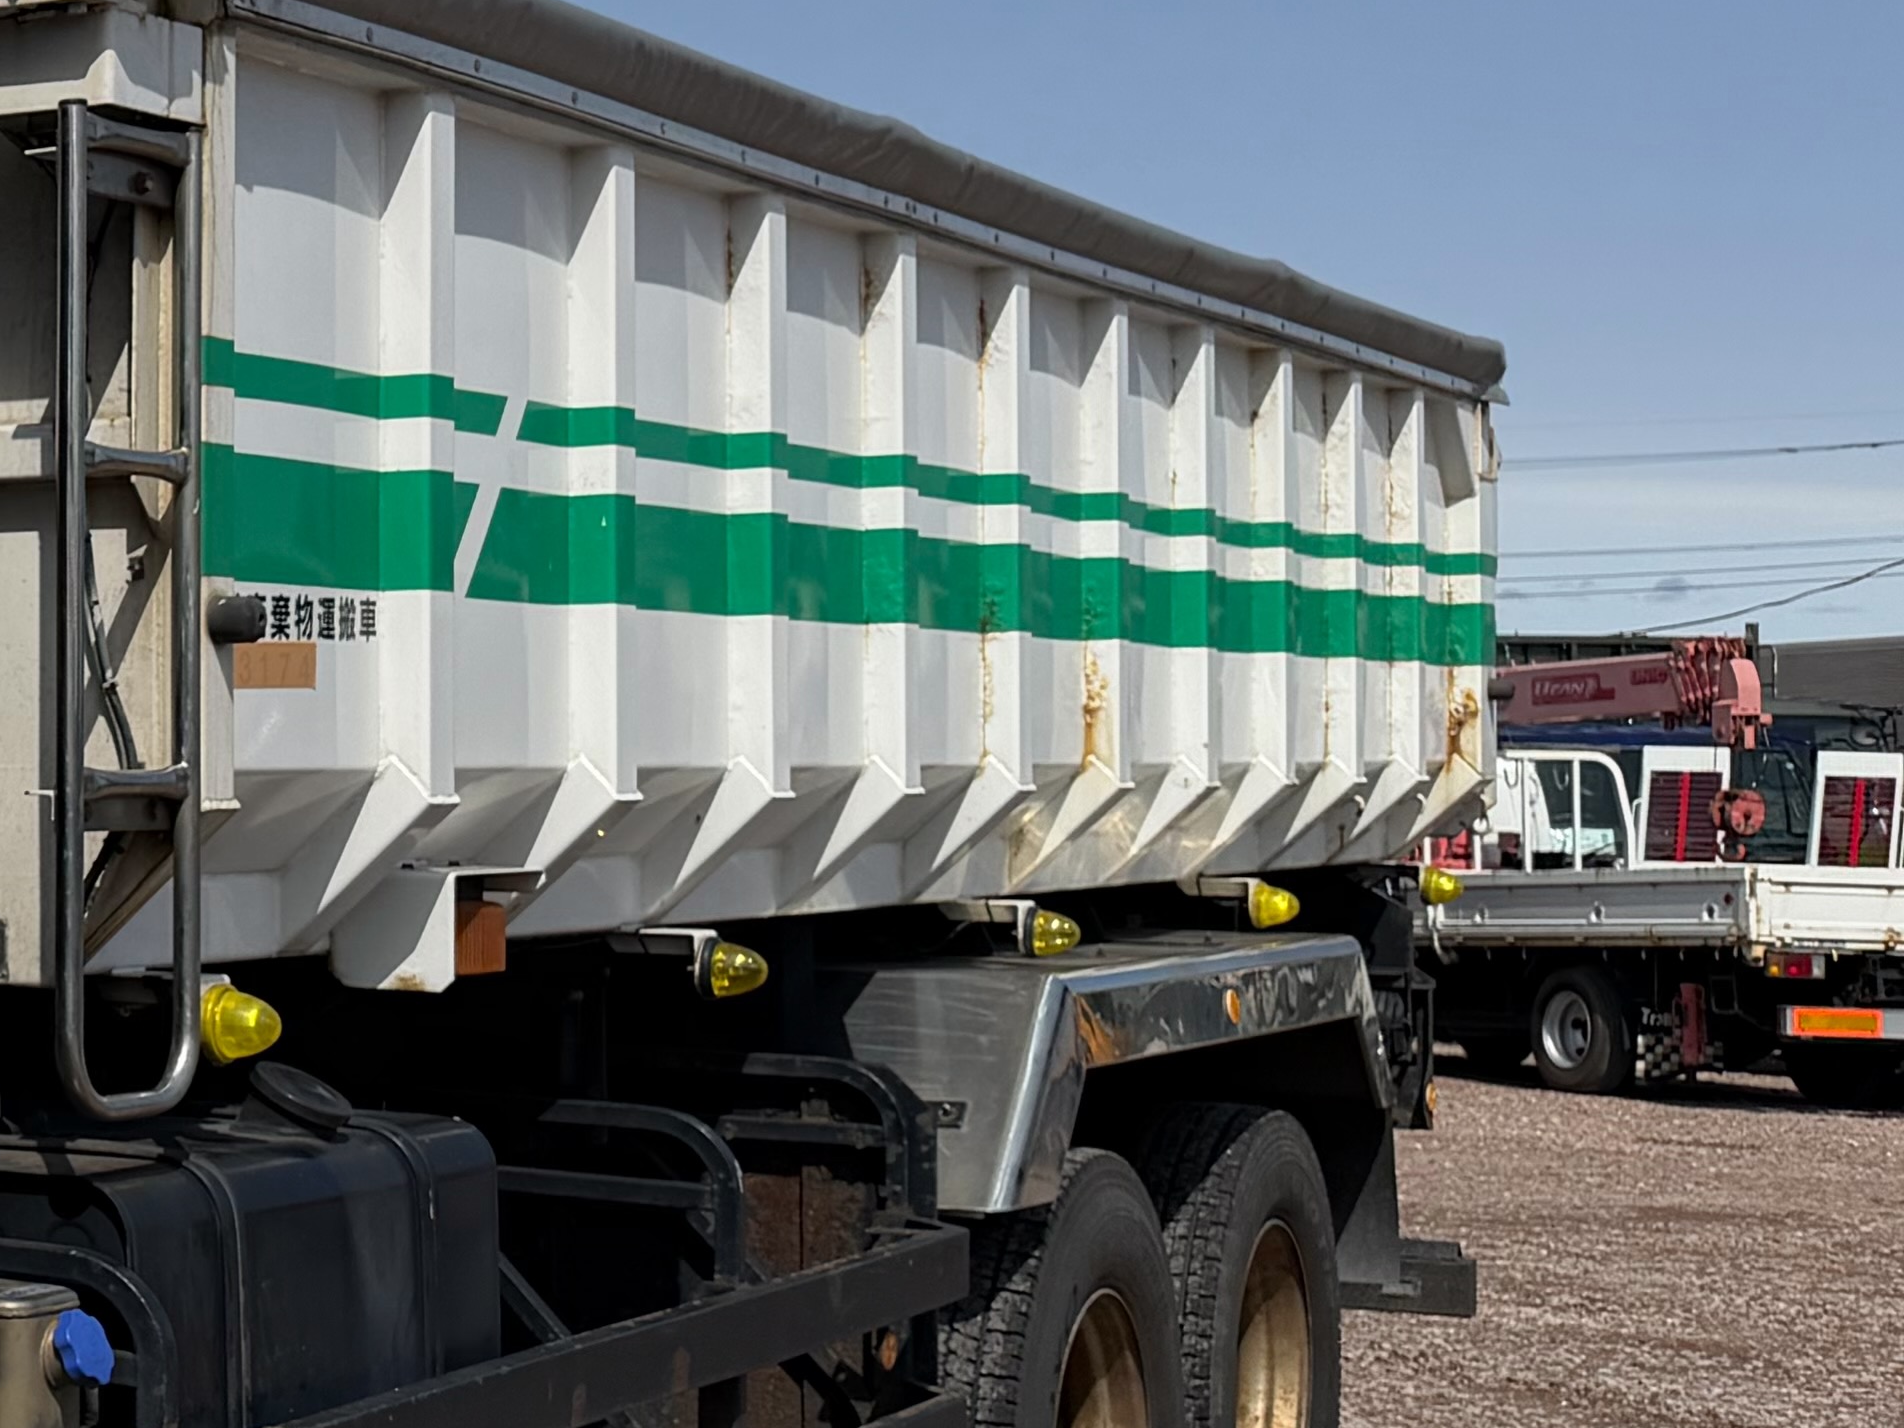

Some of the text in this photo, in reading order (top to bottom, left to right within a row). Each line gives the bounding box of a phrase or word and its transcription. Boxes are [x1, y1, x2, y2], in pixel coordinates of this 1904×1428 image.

[235, 592, 377, 642] 棄物運搬車
